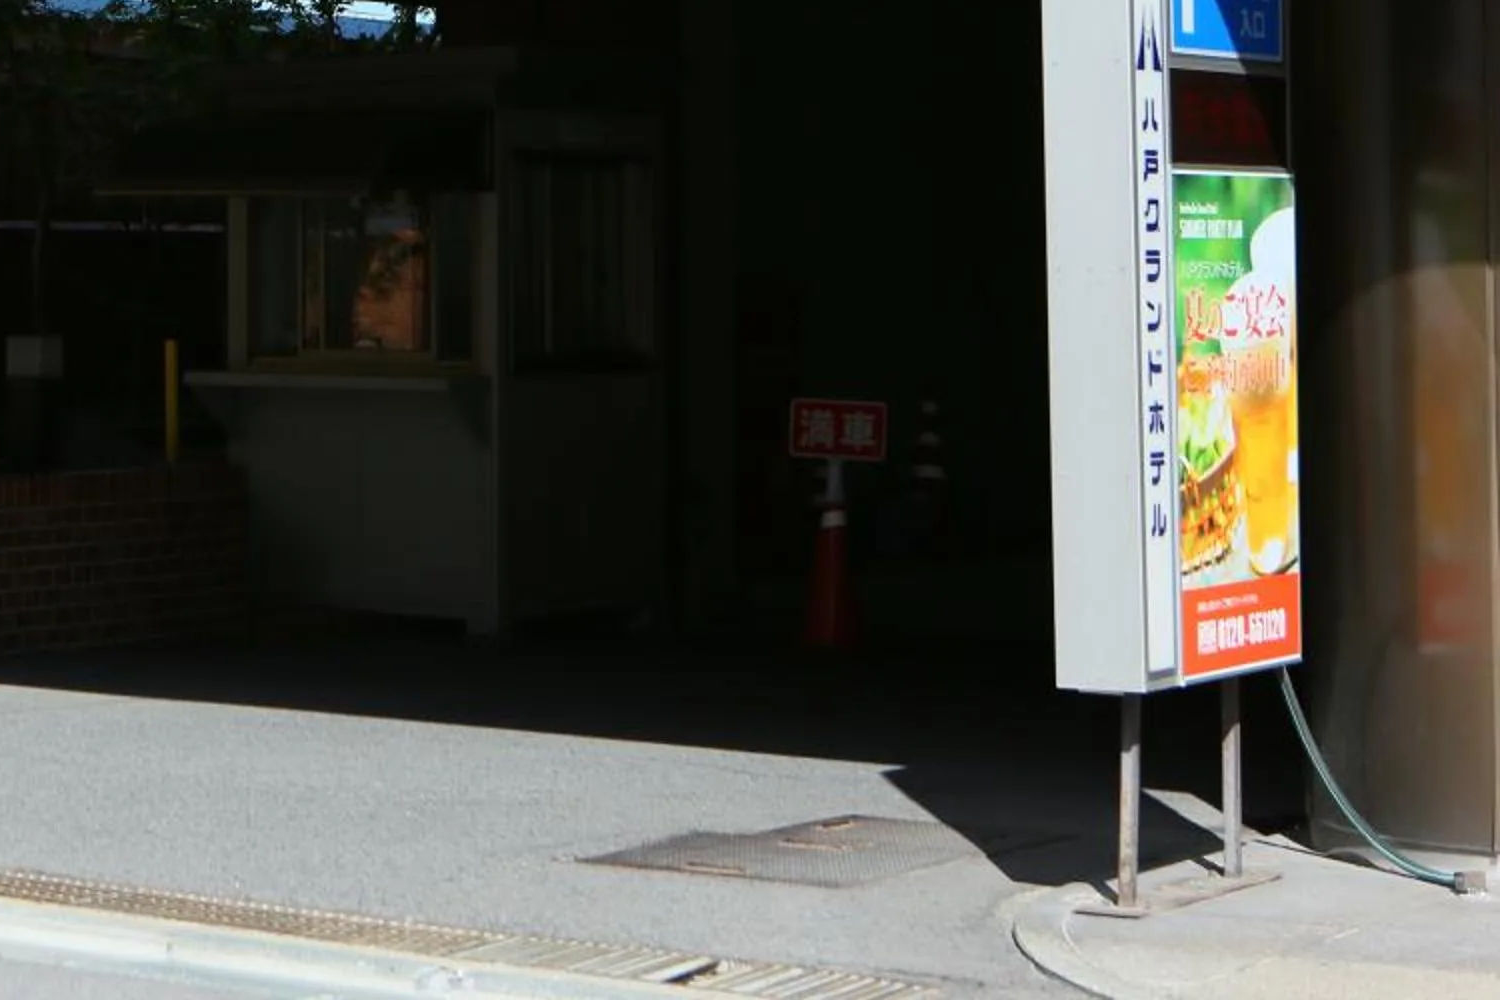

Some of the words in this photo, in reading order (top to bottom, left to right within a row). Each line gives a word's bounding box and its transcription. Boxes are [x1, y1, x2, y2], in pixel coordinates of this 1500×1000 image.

[1238, 6, 1267, 40] 入口
[1141, 97, 1168, 538] 八戸グランドホテル
